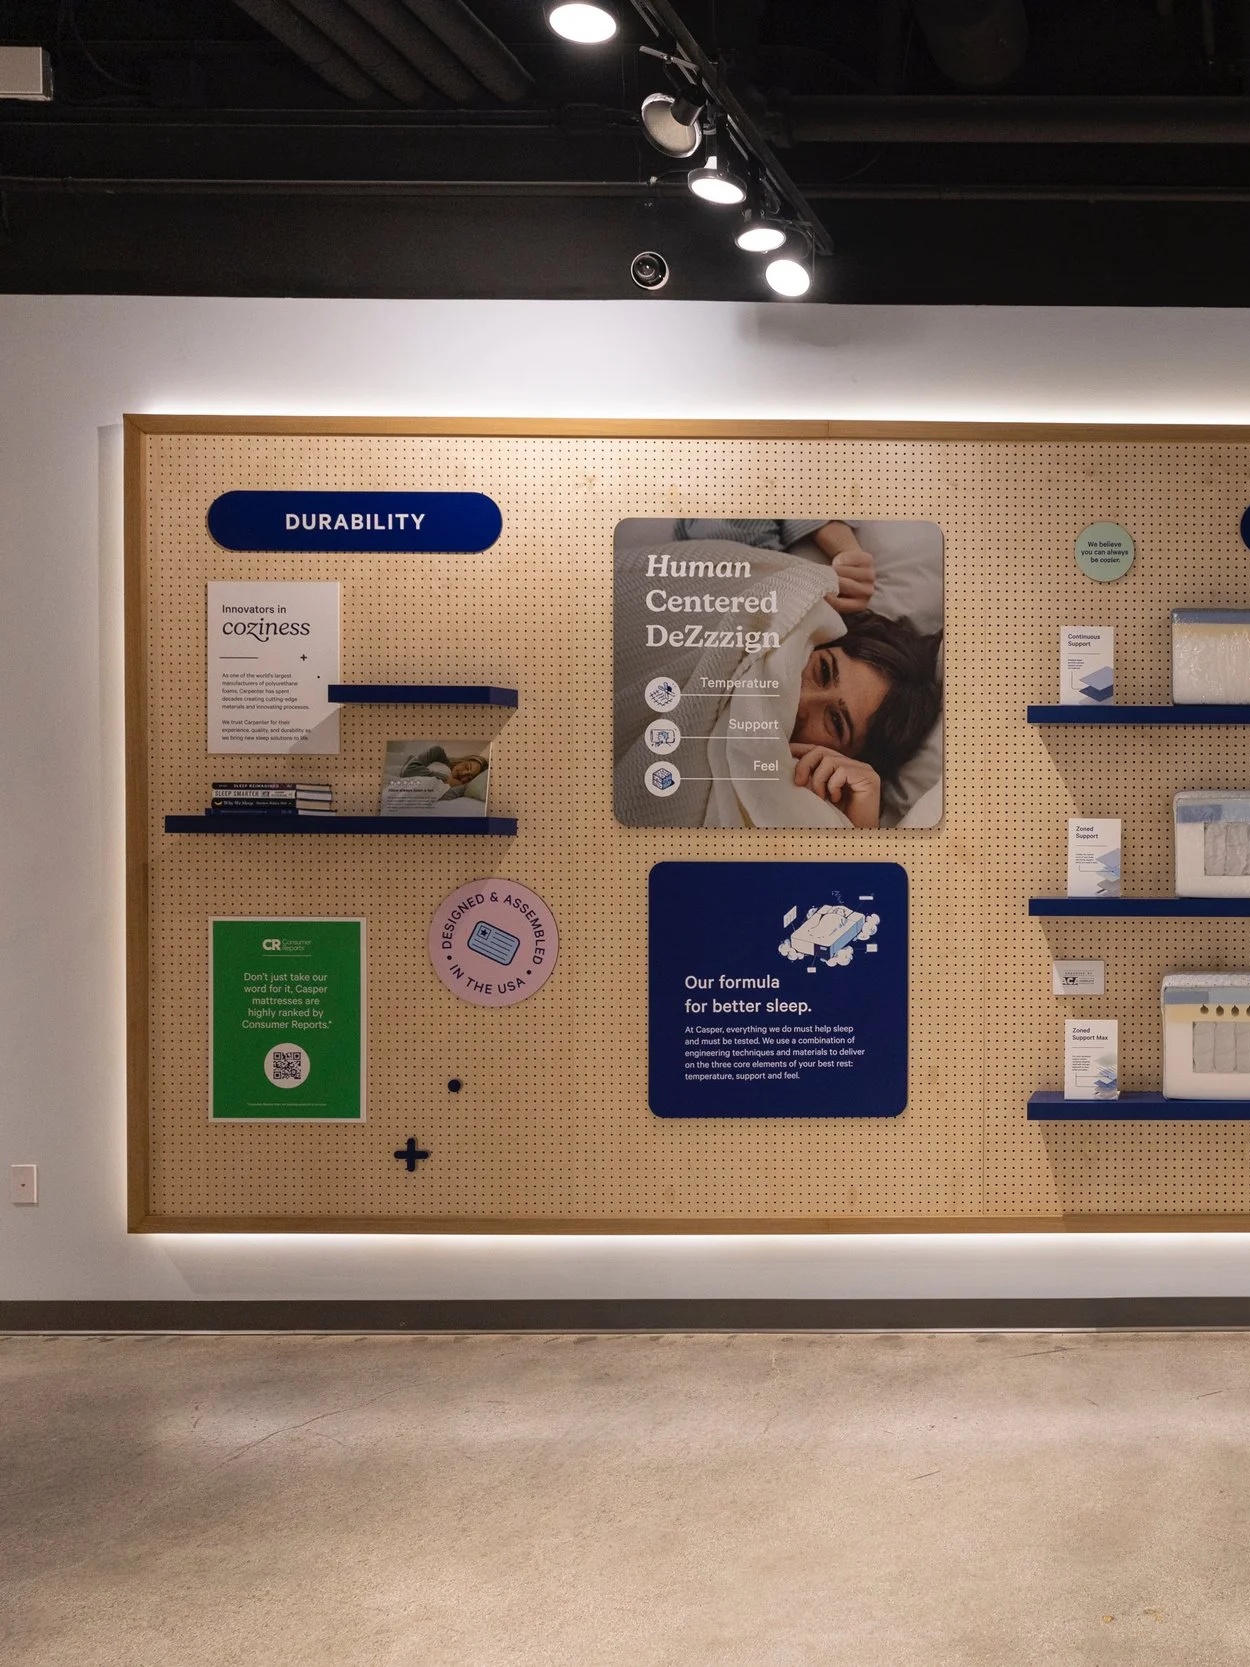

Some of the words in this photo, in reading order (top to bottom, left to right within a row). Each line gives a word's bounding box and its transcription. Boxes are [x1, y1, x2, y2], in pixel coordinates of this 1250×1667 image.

[285, 513, 426, 530] DURABILITY
[645, 554, 752, 578] Human
[644, 588, 779, 614] Centered
[222, 604, 275, 614] Innovators
[277, 604, 287, 614] in
[222, 617, 311, 643] coziness
[644, 624, 781, 654] DeZzzign
[1067, 640, 1091, 648] Support
[699, 676, 780, 691] Temperature
[728, 718, 779, 732] Support
[753, 759, 779, 772] Feel
[1075, 832, 1099, 840] Support
[441, 893, 485, 949] DESIGNED
[489, 891, 499, 903] &
[503, 894, 546, 965] ASSEMBLED
[262, 938, 282, 951] CR
[281, 938, 312, 947] Consumer
[281, 943, 305, 952] Reports
[244, 972, 269, 981] Don't
[270, 972, 288, 984] just
[290, 972, 310, 982] take
[312, 974, 328, 982] our
[449, 964, 465, 979] IN
[466, 976, 493, 995] THE
[497, 977, 526, 994] USA
[684, 975, 715, 990] Our
[718, 974, 780, 990] formula
[243, 984, 267, 993] word
[269, 984, 282, 993] for
[284, 984, 294, 994] it,
[294, 984, 329, 996] Casper
[252, 997, 303, 1005] mattresses
[305, 998, 320, 1006] are
[684, 998, 708, 1014] for
[712, 998, 762, 1013] better
[766, 998, 812, 1016] sleep.
[247, 1007, 276, 1019] highly
[278, 1008, 310, 1017] ranked
[312, 1008, 324, 1020] by
[684, 1026, 694, 1034] At
[695, 1025, 725, 1035] Casper,
[725, 1025, 768, 1035] everything
[781, 1025, 793, 1033] do
[793, 1025, 813, 1033] must
[814, 1024, 832, 1034] help
[833, 1024, 854, 1034] sleep
[684, 1037, 700, 1045] and
[722, 1037, 733, 1045] be
[734, 1037, 761, 1045] tested.
[761, 1037, 775, 1045] We
[797, 1036, 846, 1045] combination
[846, 1035, 855, 1044] of
[684, 1049, 731, 1059] engineering
[732, 1048, 775, 1058] techniques
[776, 1047, 791, 1056] and
[792, 1047, 828, 1056] materials
[839, 1047, 865, 1056] deliver
[696, 1061, 710, 1069] the
[711, 1060, 732, 1069] three
[751, 1060, 788, 1068] elements
[788, 1059, 797, 1068] of
[798, 1061, 816, 1069] your
[817, 1059, 835, 1068] best
[836, 1060, 854, 1068] rest:
[684, 1073, 734, 1082] temperature,
[735, 1072, 766, 1081] support
[767, 1071, 782, 1080] and
[783, 1071, 800, 1080] feel.
